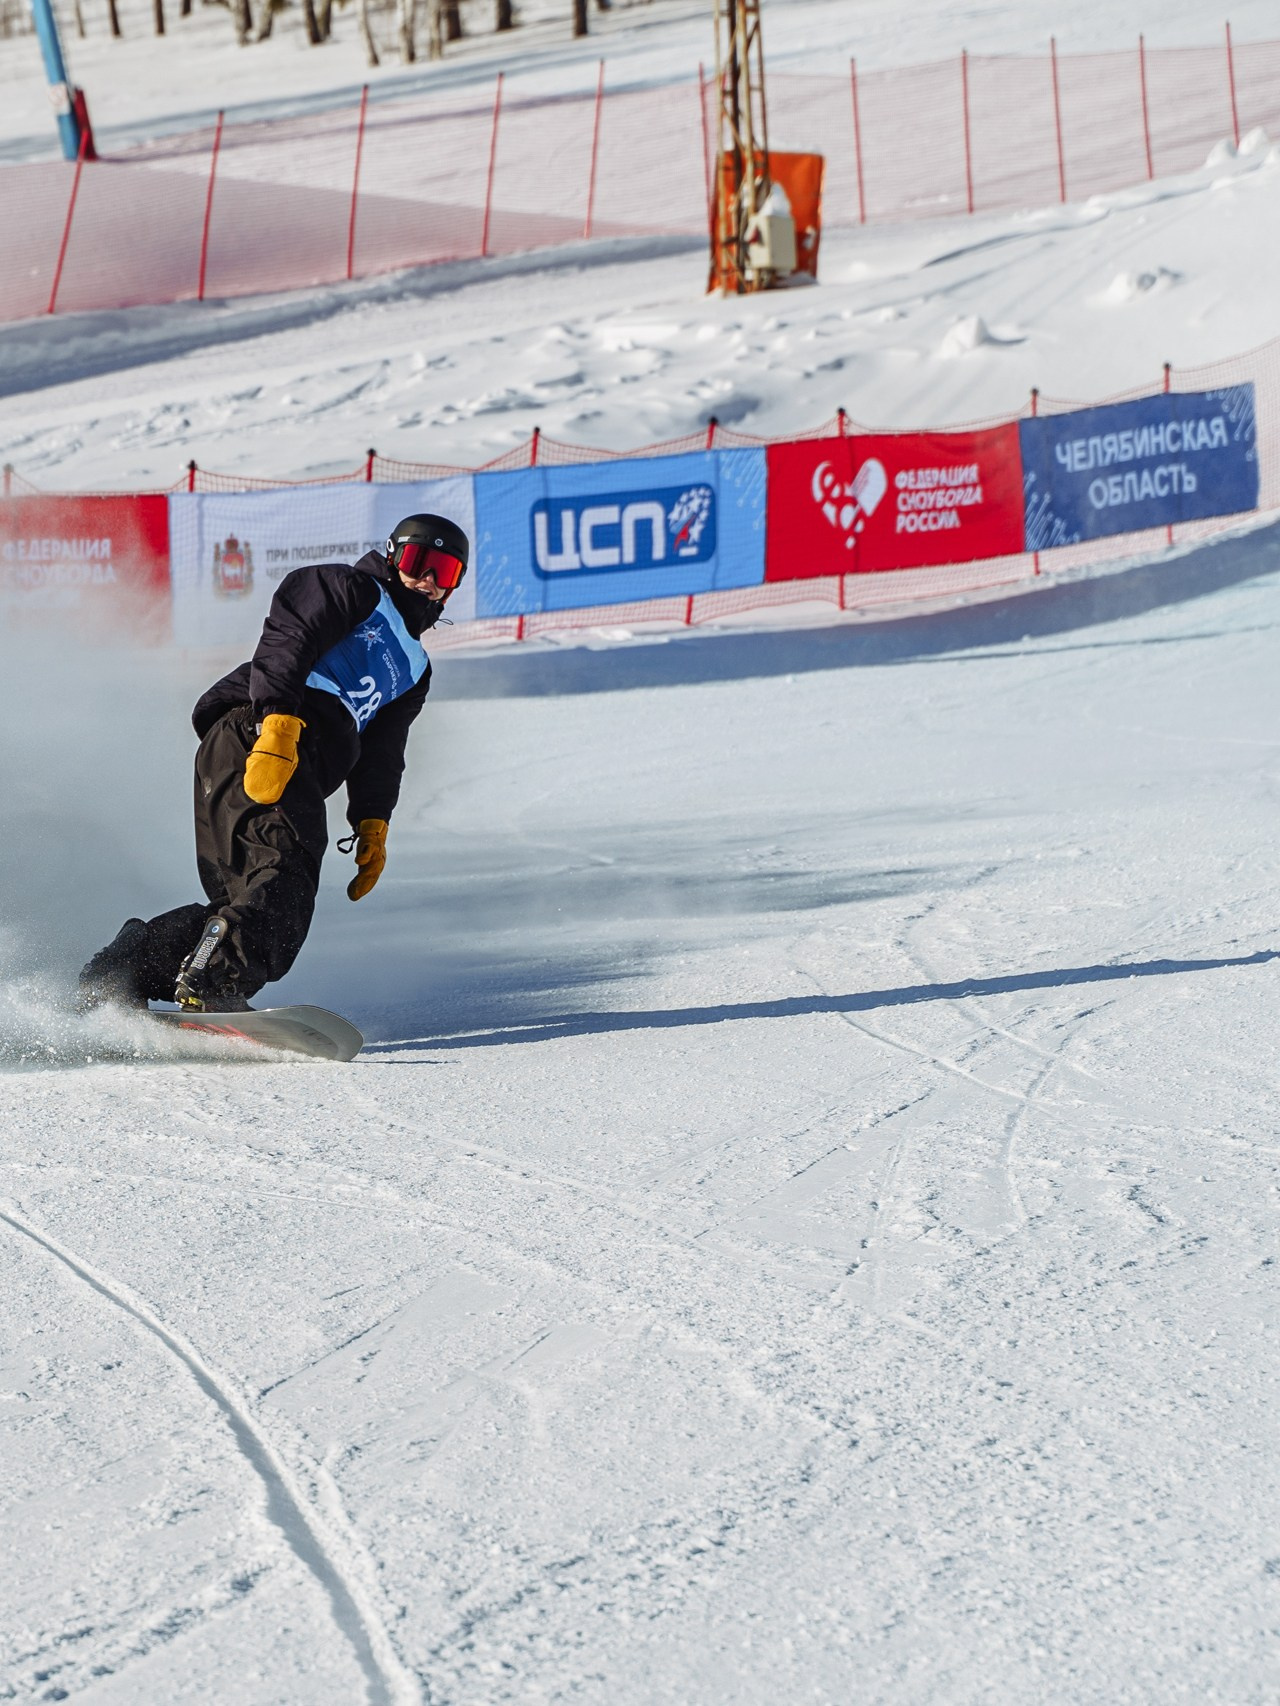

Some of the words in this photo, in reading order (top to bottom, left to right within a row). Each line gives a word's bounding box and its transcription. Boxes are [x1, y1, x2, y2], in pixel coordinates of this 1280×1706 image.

[1055, 416, 1228, 473] ЧЕЛЯБИНСКАЯ
[895, 463, 978, 490] ФЕДЕРАЦИЯ
[1088, 463, 1197, 509] ОБЛАСТЬ
[897, 485, 983, 512] СНОУБОРДА
[2, 538, 112, 560] ФЕДЕРАЦИЯ
[266, 548, 289, 562] ПРИ
[291, 542, 359, 563] ПОДДЕРЖКЕ
[534, 501, 665, 573] ЦСП
[346, 675, 382, 721] 28
[191, 936, 218, 969] TERROR
